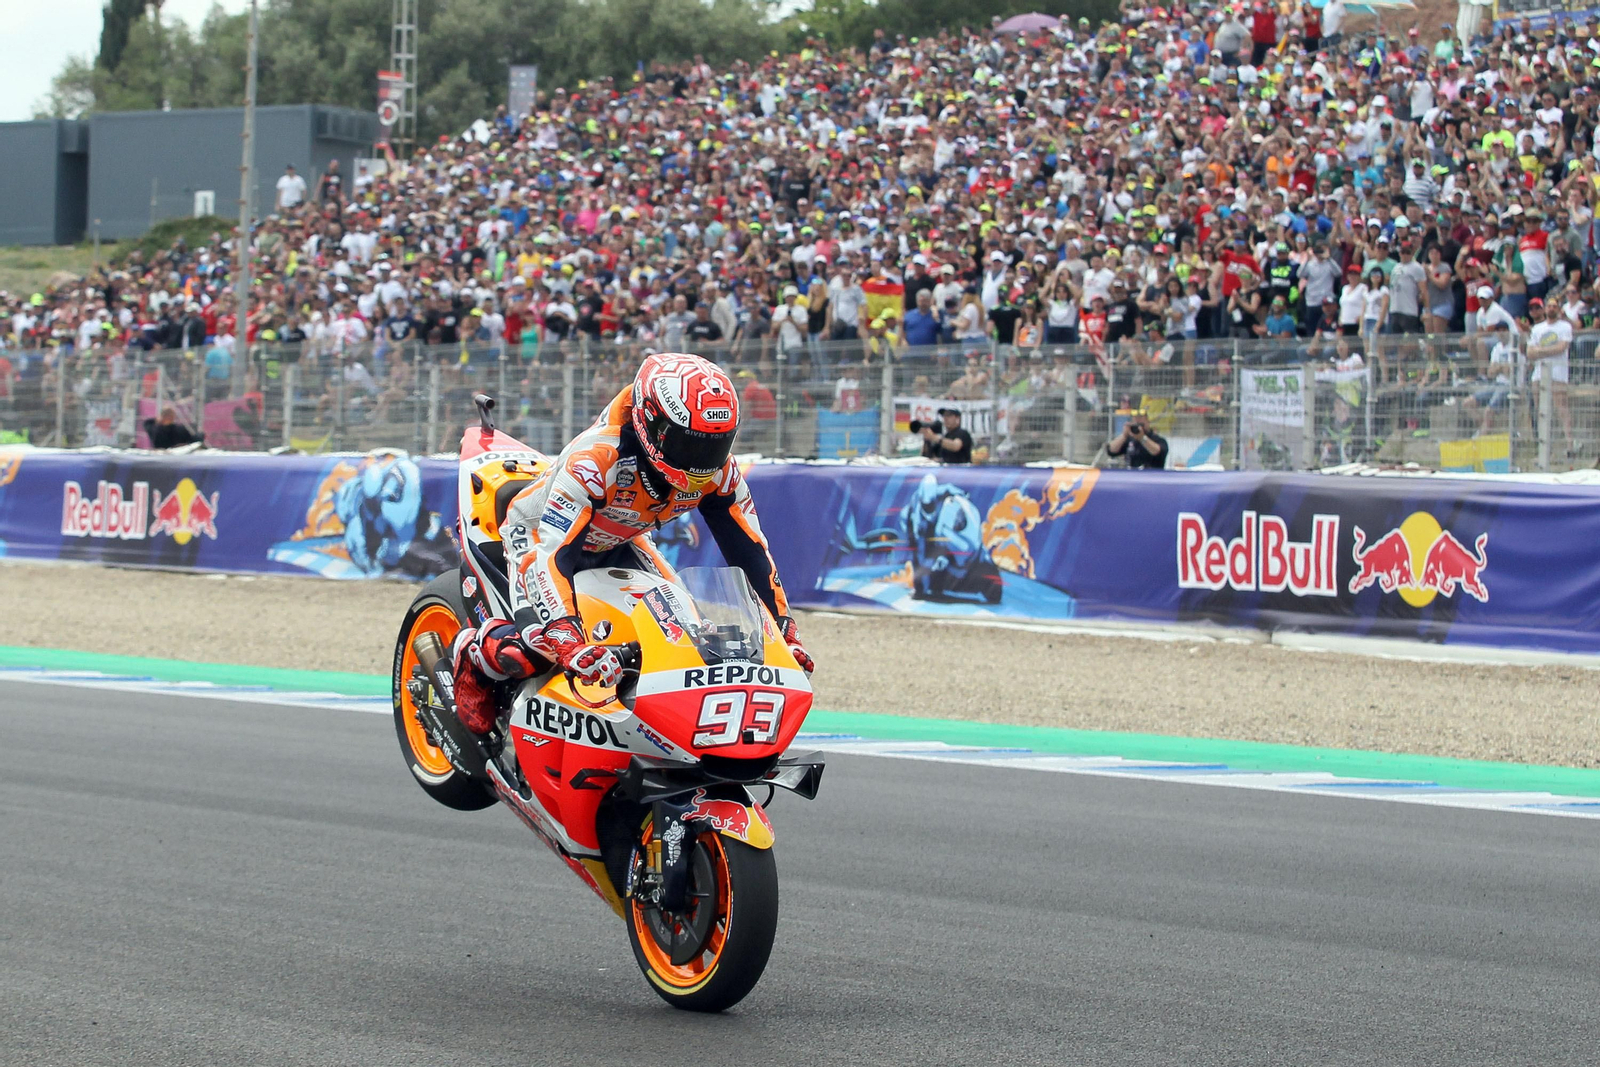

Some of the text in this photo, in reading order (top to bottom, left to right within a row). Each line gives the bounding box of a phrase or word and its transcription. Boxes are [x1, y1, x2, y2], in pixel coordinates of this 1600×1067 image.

[658, 378, 688, 424] PULL&BEAR
[706, 410, 729, 420] SHOEI
[684, 429, 707, 438] GIVES
[710, 432, 725, 440] YOU
[640, 471, 661, 500] REPSOL
[676, 490, 700, 500] SHOEI
[606, 507, 629, 517] Allianz
[537, 570, 548, 590] Satu
[525, 568, 552, 624] REPSO
[683, 665, 785, 688] REPSOL
[525, 697, 629, 749] REPSOL
[691, 689, 786, 749] 93
[636, 723, 675, 755] HRC
